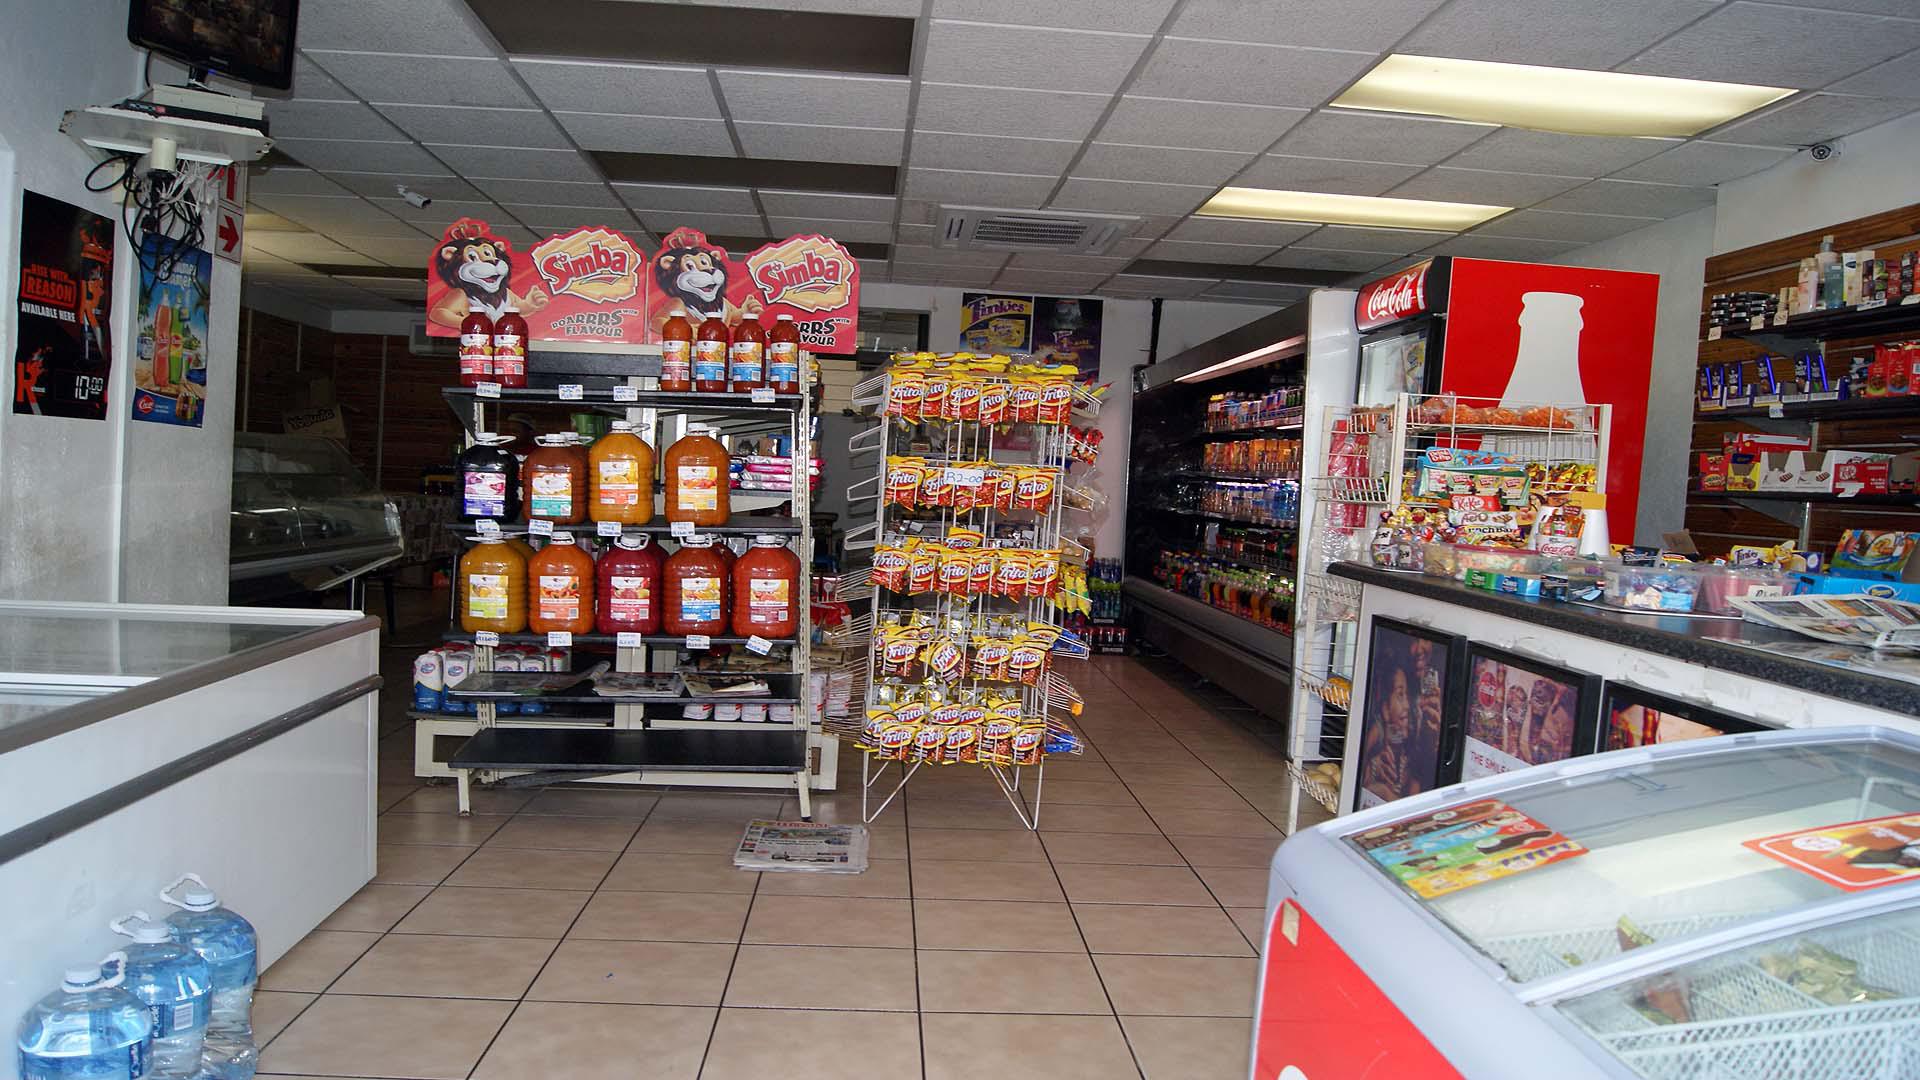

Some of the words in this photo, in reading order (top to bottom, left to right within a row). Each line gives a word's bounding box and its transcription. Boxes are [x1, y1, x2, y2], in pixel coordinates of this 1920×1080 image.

[541, 242, 629, 293] Simba
[756, 251, 842, 303] Simba
[27, 274, 73, 304] REASON
[1367, 271, 1417, 320] Coca-Cola
[21, 302, 57, 317] AVAILABLE
[58, 307, 76, 322] HERE
[552, 311, 622, 329] ROARRRS
[566, 326, 623, 337] FLAVOUR
[1043, 388, 1070, 402] Fritos
[1018, 481, 1048, 494] Fritos
[887, 645, 916, 659] Fritos
[1011, 652, 1041, 664] Fritos
[881, 731, 912, 745] Fritos
[946, 730, 973, 745] Fritos
